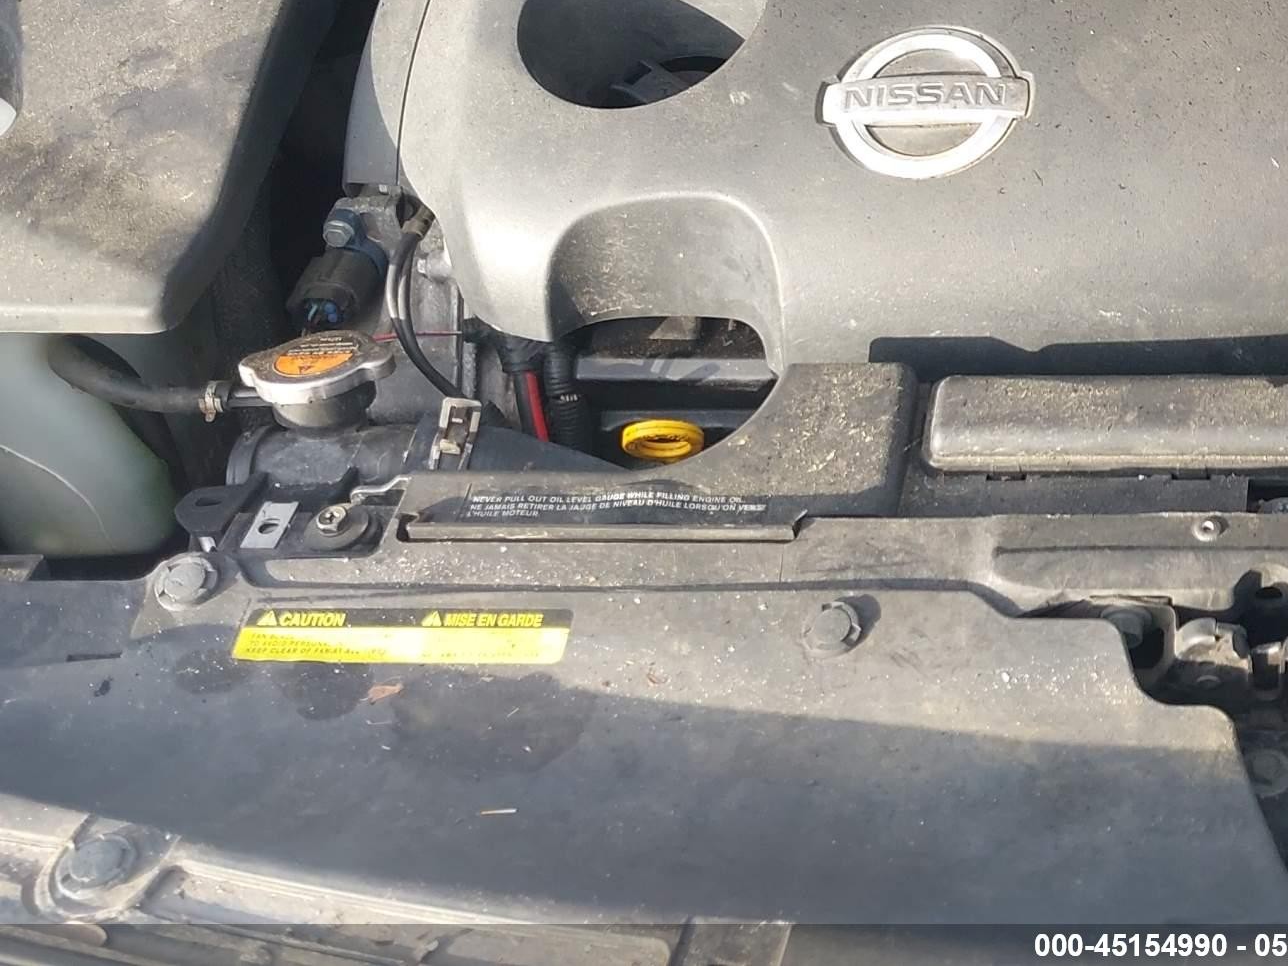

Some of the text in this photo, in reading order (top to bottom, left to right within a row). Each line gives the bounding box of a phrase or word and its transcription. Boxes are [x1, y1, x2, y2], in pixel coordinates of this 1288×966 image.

[843, 81, 1007, 112] NISSAN
[473, 495, 502, 503] NEVER
[503, 495, 525, 503] PULL
[528, 495, 547, 503] OUT
[566, 495, 592, 503] LEVEL
[595, 493, 625, 502] GAUGE
[627, 491, 653, 499] WHILE
[656, 492, 690, 501] FILLING
[692, 494, 726, 503] ENGINE
[517, 503, 554, 511] RETIRER
[570, 503, 597, 511] JAUGE
[613, 499, 645, 508] NIVEAU
[279, 612, 347, 627] CAUTION
[444, 613, 544, 627] MISE EN GARDE
